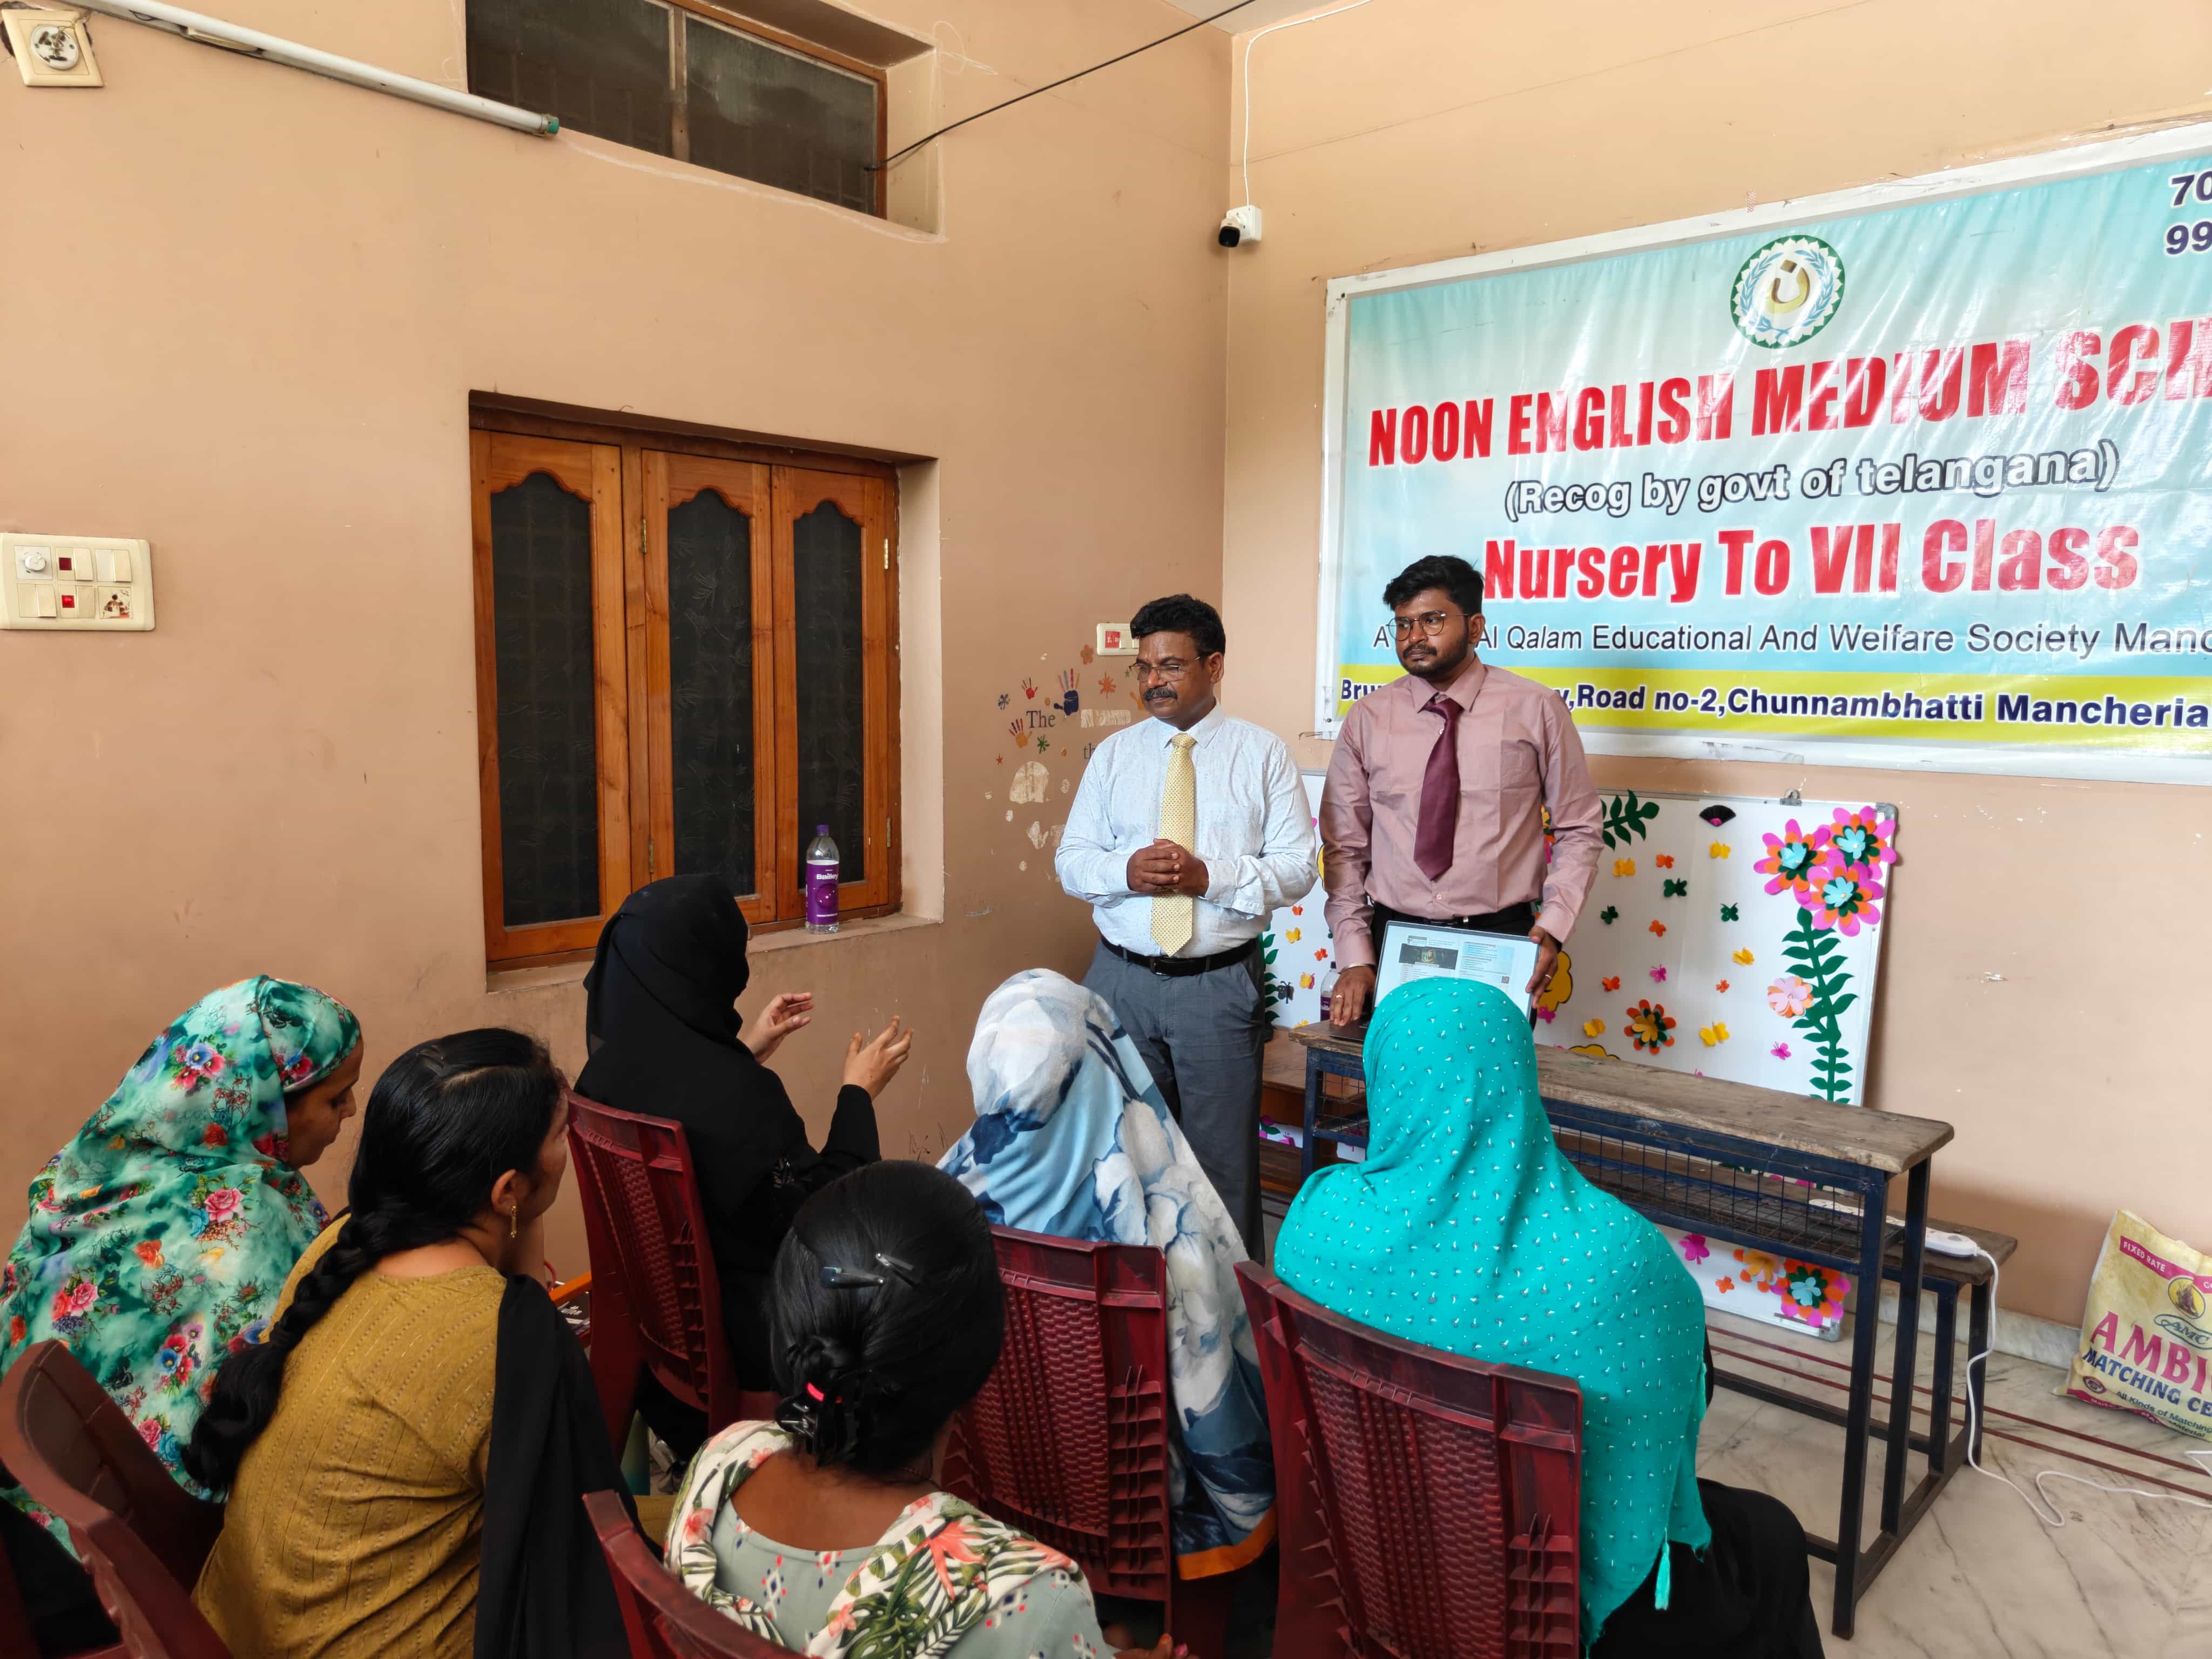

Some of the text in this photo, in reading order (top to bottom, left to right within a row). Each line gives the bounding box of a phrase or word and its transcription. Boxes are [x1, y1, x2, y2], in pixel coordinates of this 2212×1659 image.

[1369, 399, 1494, 467] NOON
[1507, 373, 1734, 455] ENGLISH
[1751, 339, 2031, 436] MEDIUM
[1506, 439, 2119, 522] (Recog by govt of telangana)
[1484, 518, 2139, 603] Nursery To VII Class
[1475, 625, 1497, 649] Al
[1507, 625, 1582, 651] Qalam
[1593, 624, 1751, 651] Educational
[1758, 624, 1817, 652] And
[1830, 623, 1953, 652] Welfare
[1967, 622, 2100, 660] Society
[1026, 710, 1056, 729] The
[1997, 695, 2209, 727] Mancheria
[2123, 1241, 2167, 1273] FIXED RATE
[2161, 1319, 2210, 1345] AMC
[2090, 1310, 2212, 1394] AMBI
[2082, 1347, 2182, 1406] MATCHING
[2129, 1395, 2155, 1413] Kinds
[2157, 1408, 2169, 1418] of
